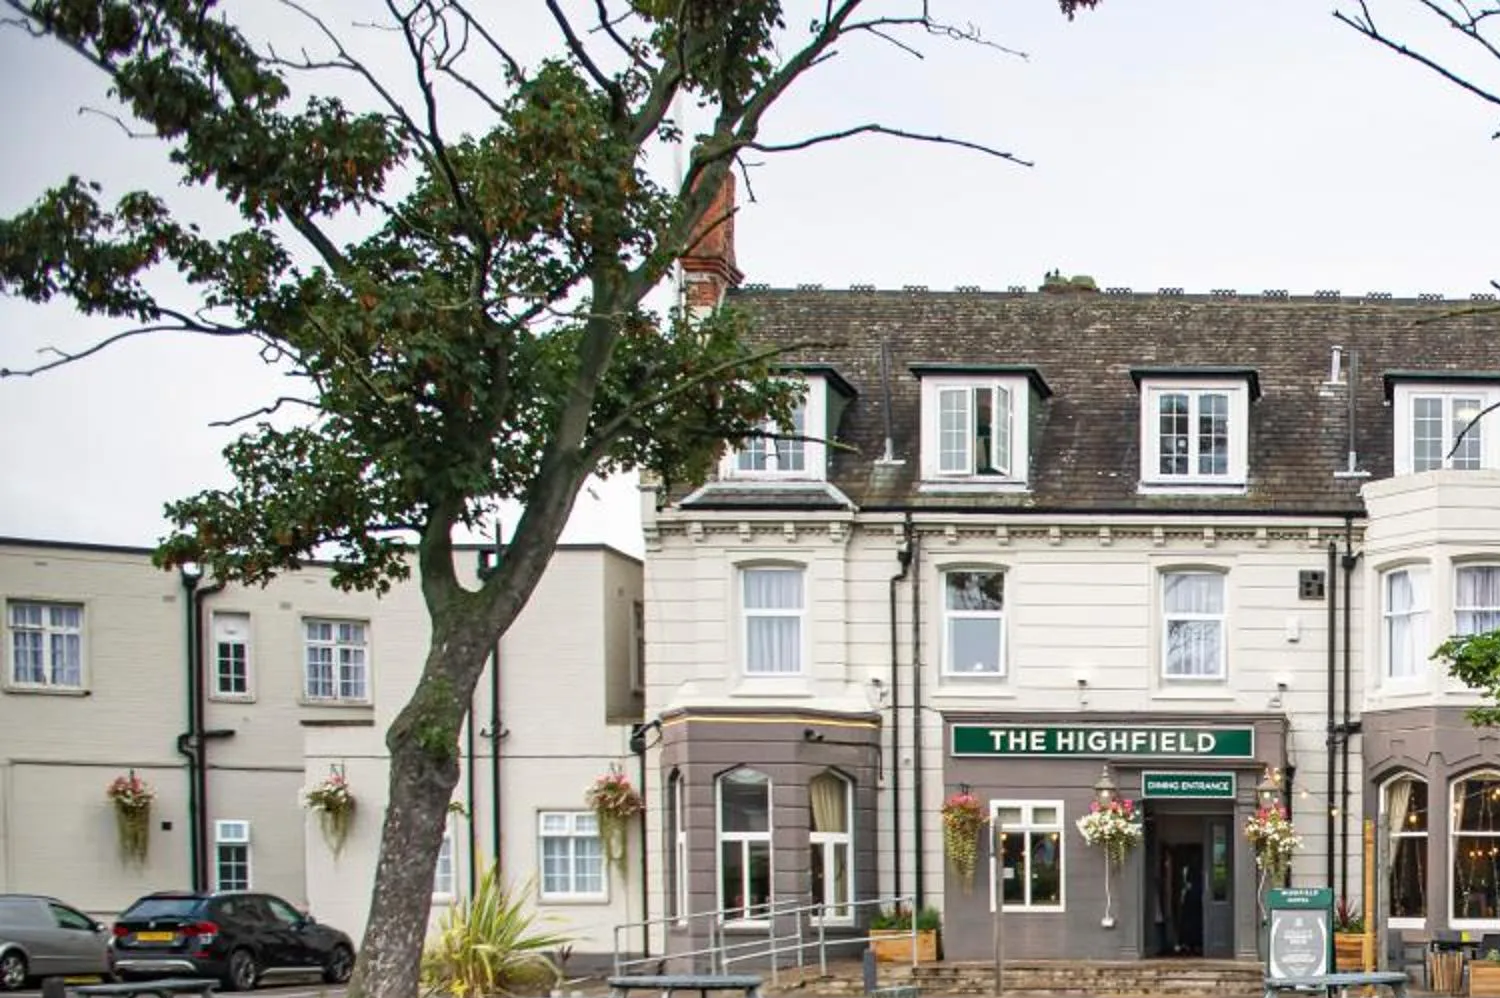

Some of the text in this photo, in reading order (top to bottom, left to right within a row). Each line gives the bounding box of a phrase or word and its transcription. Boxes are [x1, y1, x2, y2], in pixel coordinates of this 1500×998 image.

[989, 730, 1216, 753] THE HIGHFIELD
[1147, 781, 1230, 791] DINING ENTRANCE
